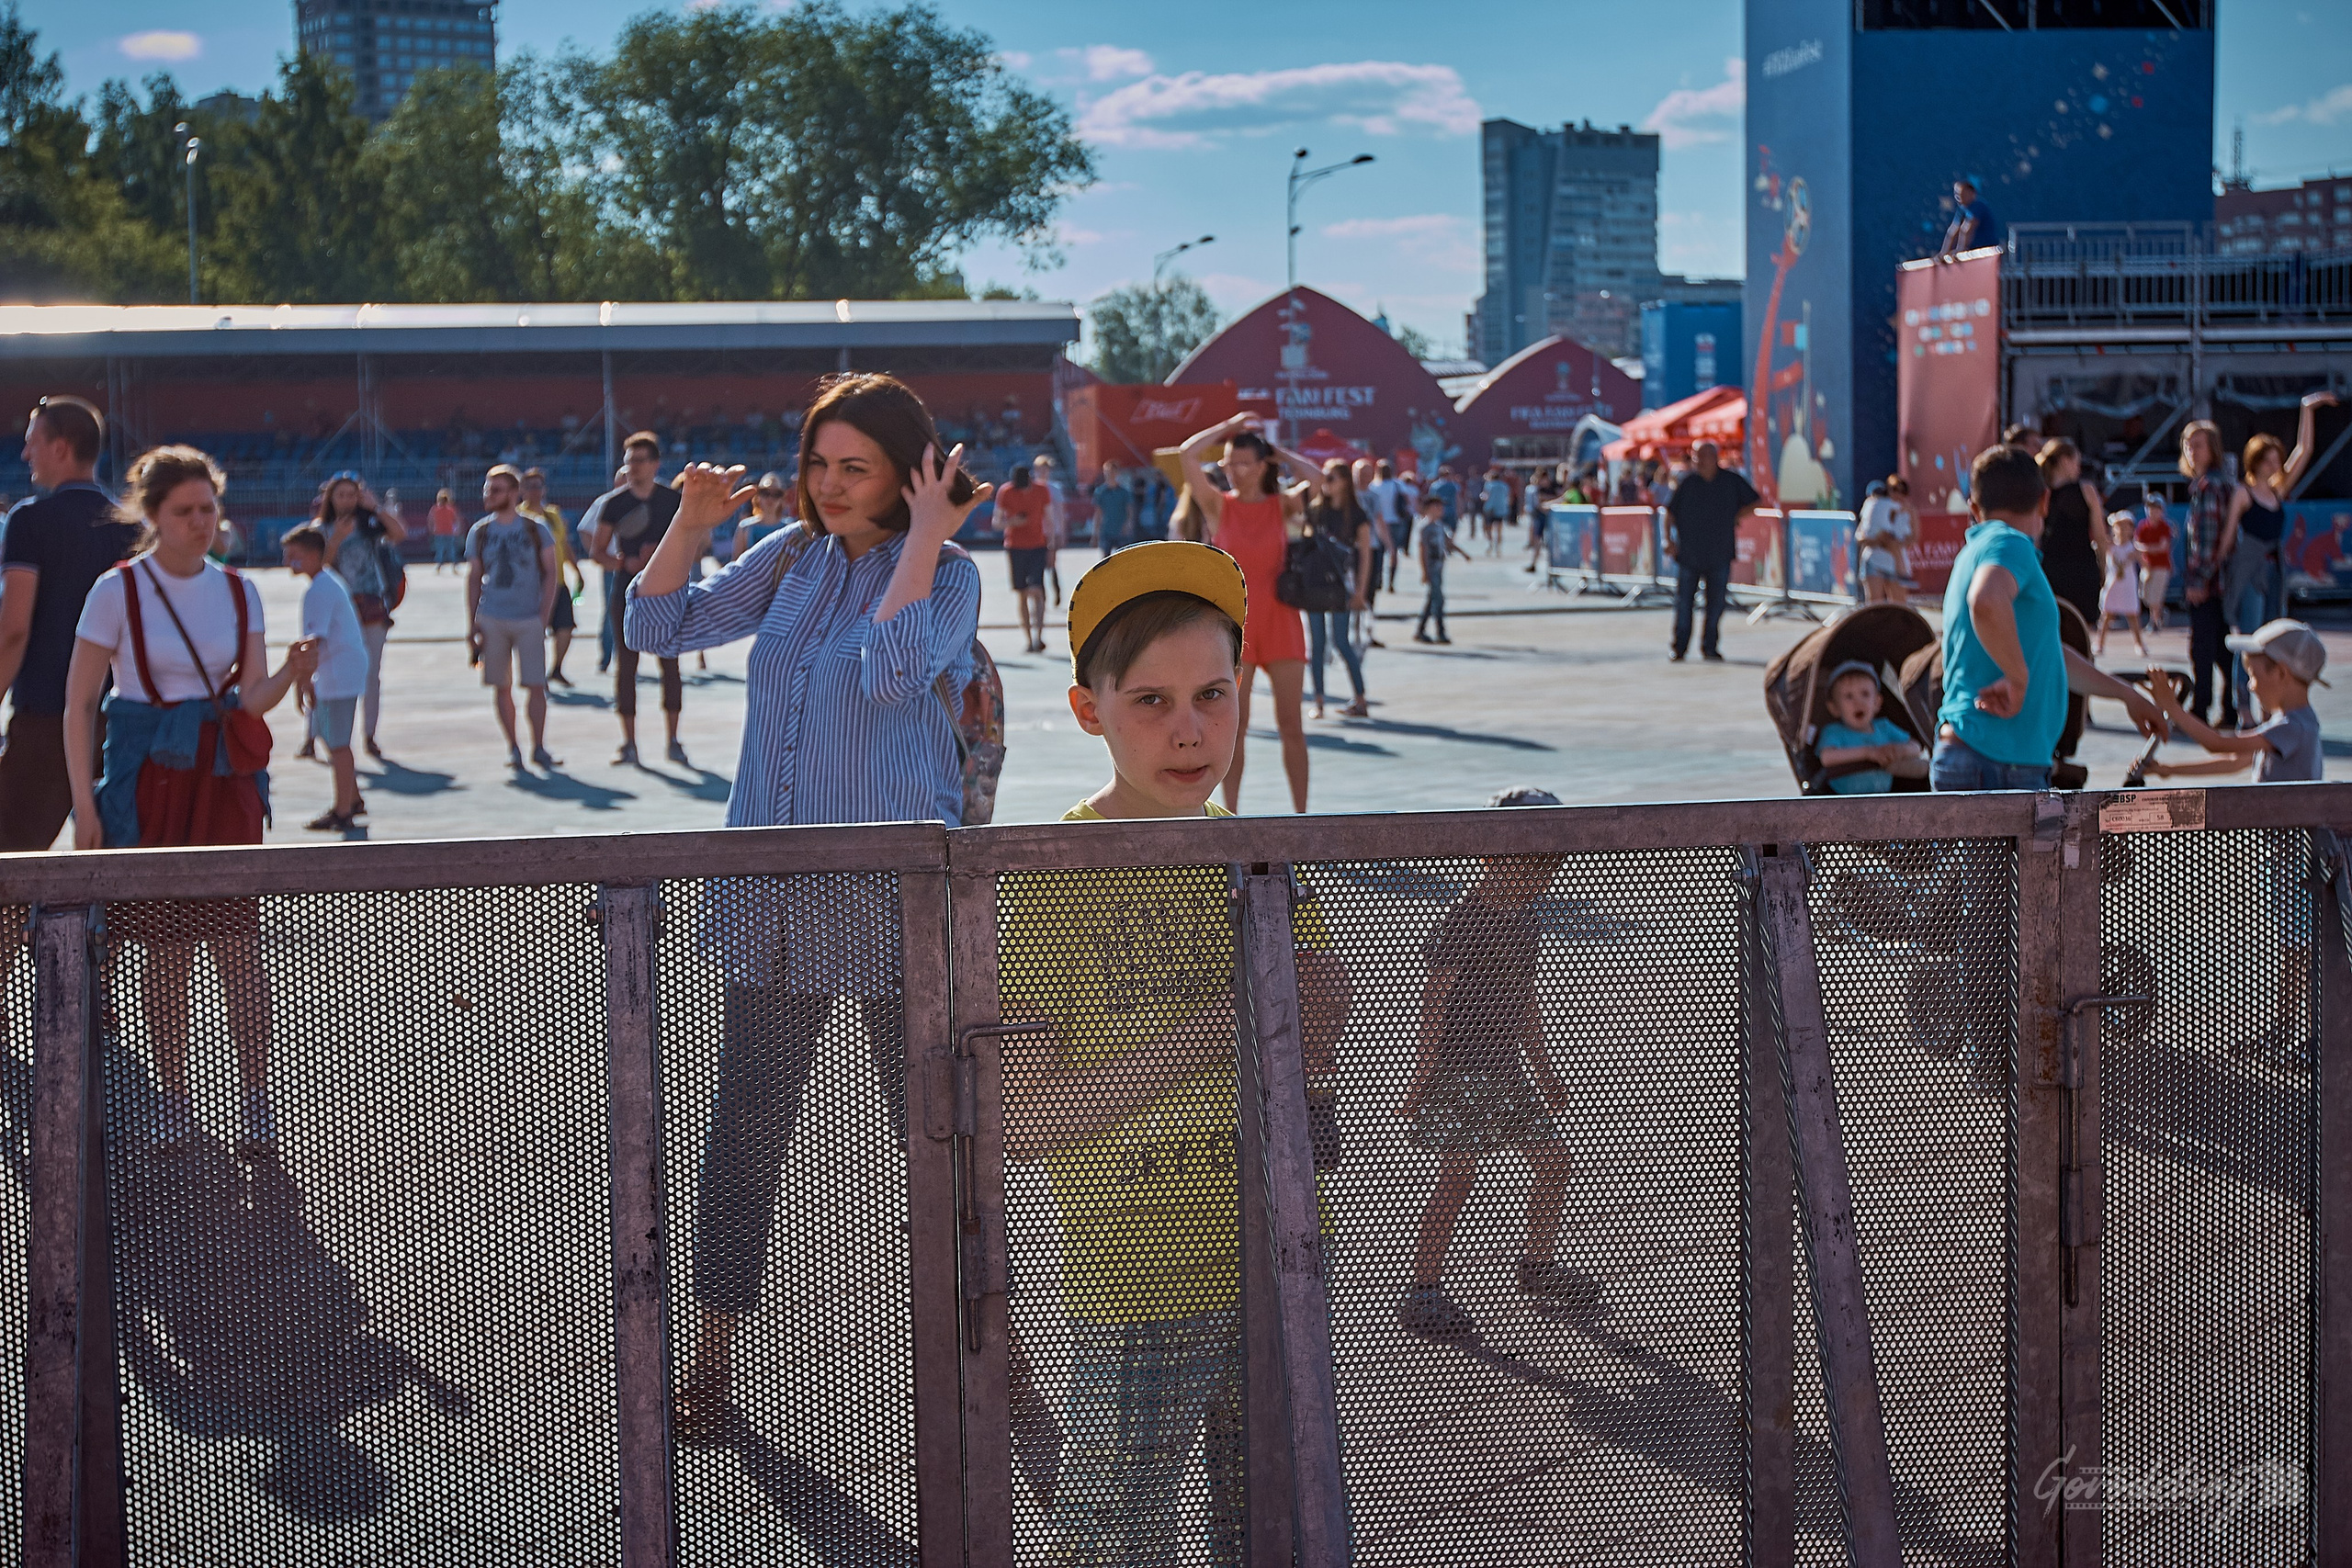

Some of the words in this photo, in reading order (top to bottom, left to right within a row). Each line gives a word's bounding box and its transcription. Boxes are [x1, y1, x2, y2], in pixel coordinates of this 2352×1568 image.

[1274, 386, 1321, 405] FAN
[1323, 386, 1376, 406] FEST
[2120, 794, 2137, 803] BSP
